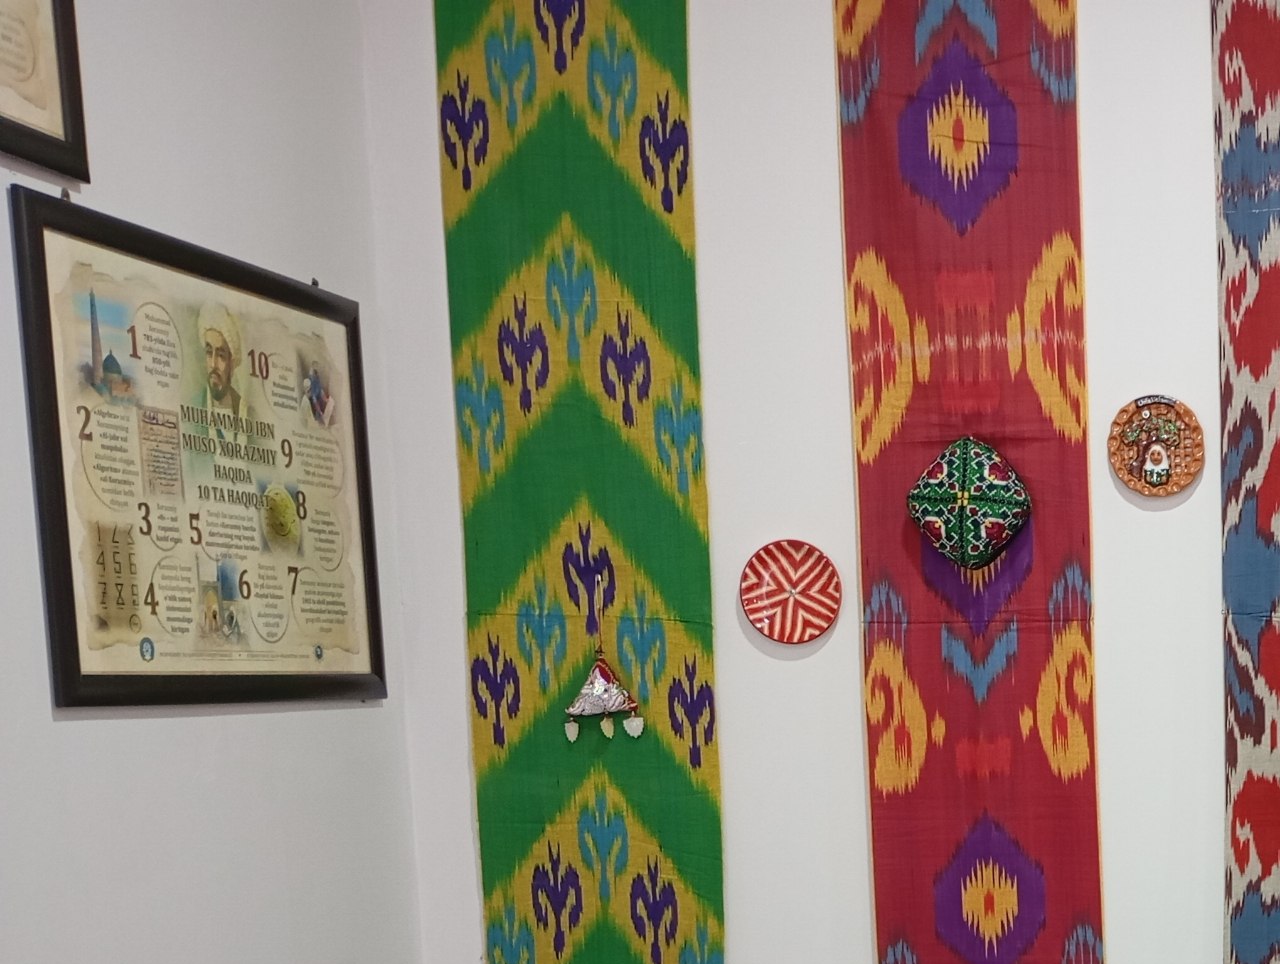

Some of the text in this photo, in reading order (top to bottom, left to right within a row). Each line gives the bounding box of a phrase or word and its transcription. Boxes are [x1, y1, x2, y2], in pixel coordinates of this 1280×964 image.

[127, 325, 142, 360] 1
[247, 349, 269, 380] 10
[76, 405, 93, 441] 2
[180, 404, 275, 440] MUHAMMAD IBN
[182, 433, 278, 466] MUSO XORAZMIY
[281, 438, 293, 469] 9
[213, 464, 253, 485] HAQIDA
[198, 485, 271, 510] 10 TA HAQIQAT
[296, 490, 307, 520] 8
[138, 502, 152, 536] 3
[189, 512, 202, 545] 5
[239, 569, 251, 600] 6
[287, 566, 298, 595] 7
[144, 582, 159, 615] 4
